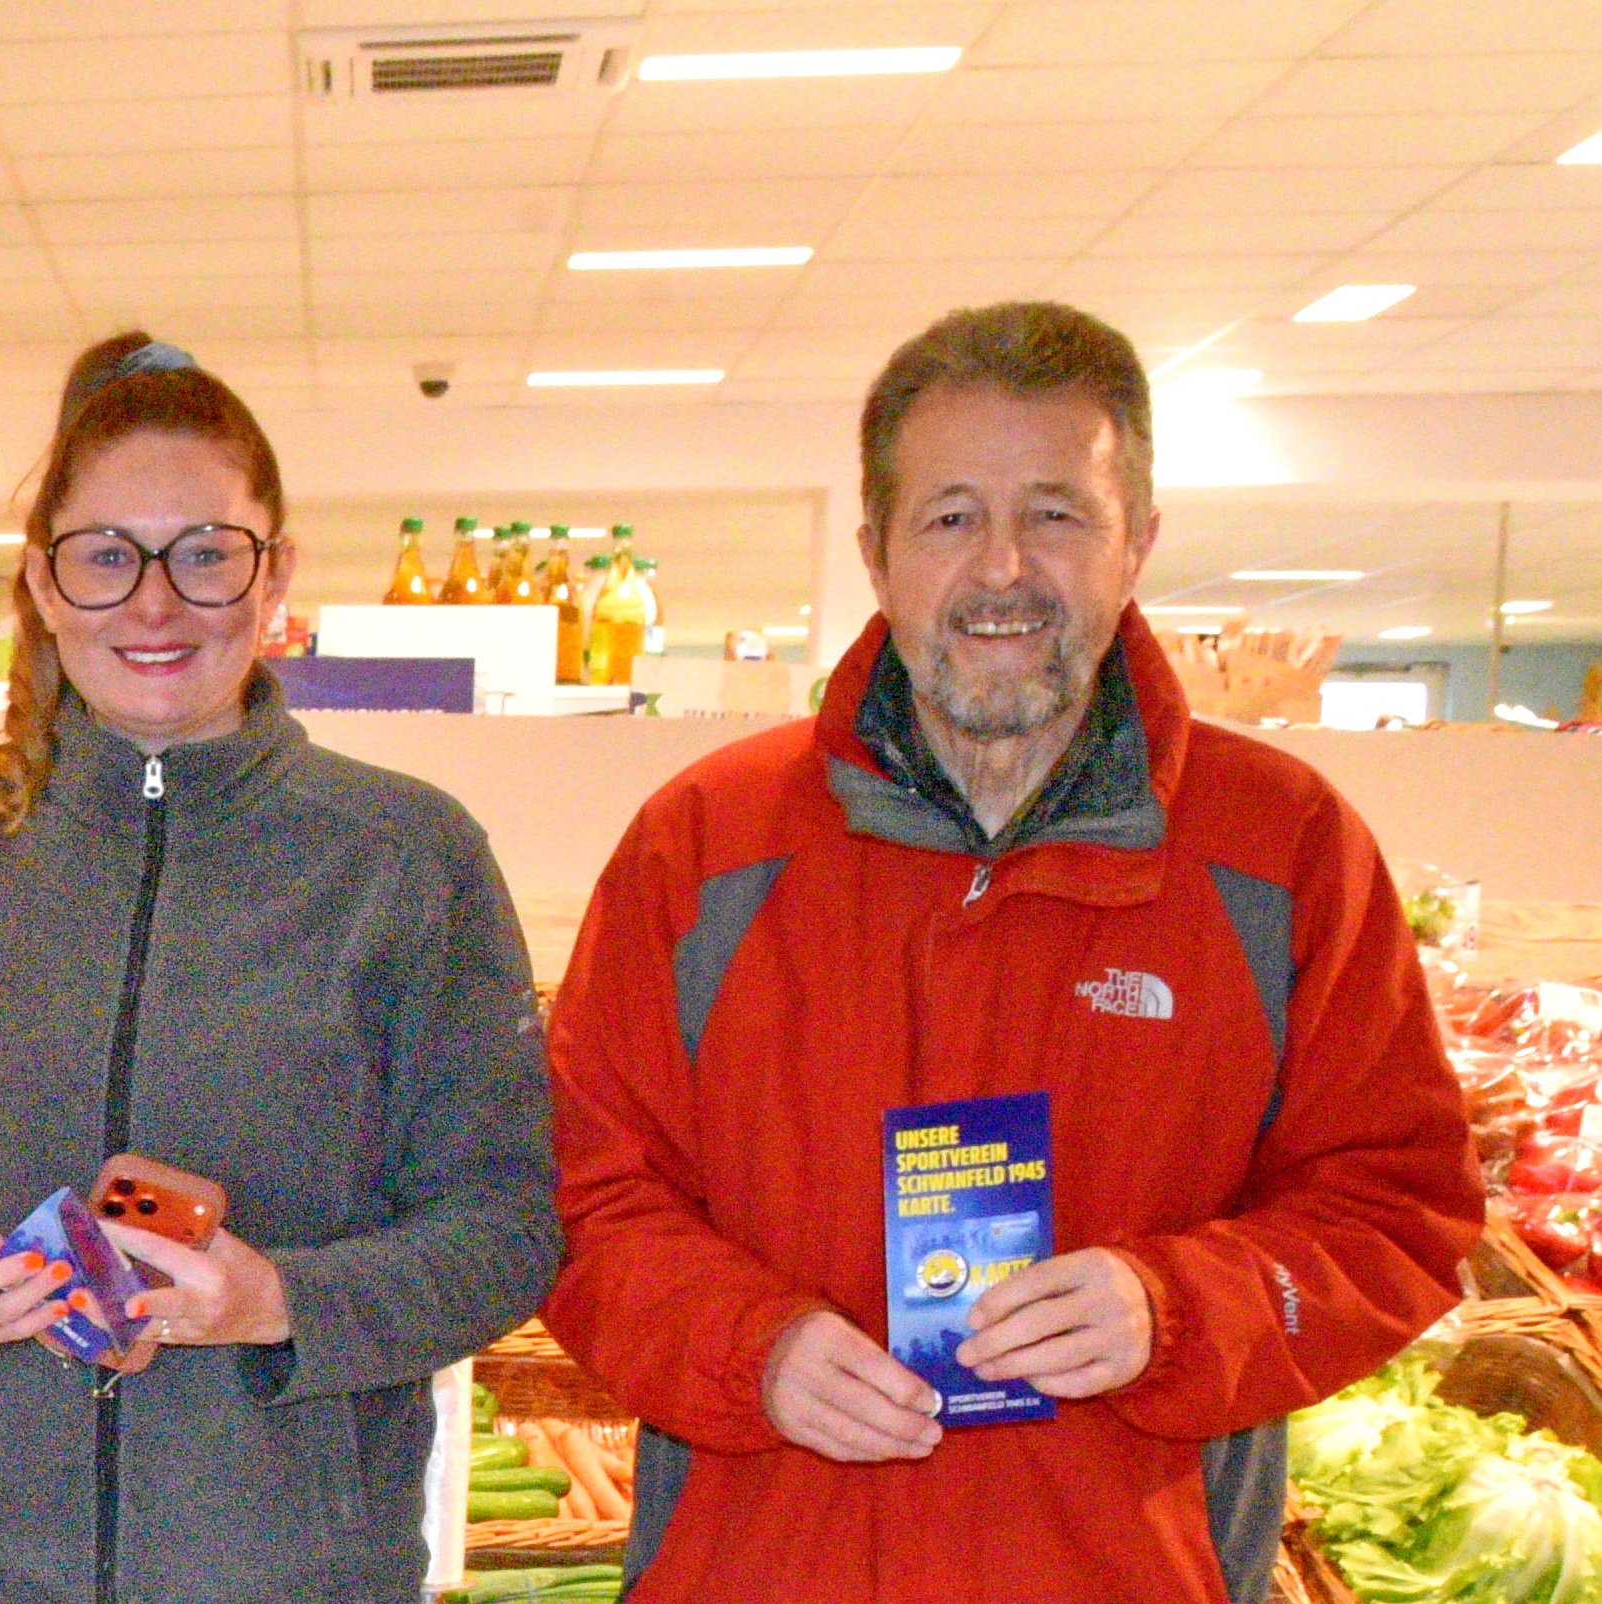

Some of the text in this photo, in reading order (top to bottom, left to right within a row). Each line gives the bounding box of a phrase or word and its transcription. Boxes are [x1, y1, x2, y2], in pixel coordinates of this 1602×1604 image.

[1104, 967, 1143, 985] THE
[1075, 981, 1141, 1001] NORTH
[1090, 998, 1141, 1017] FACE
[896, 1125, 960, 1150] UNSERE
[897, 1142, 1008, 1173] SPORTVEREIN
[897, 1160, 1046, 1195] SCHWANFELD 1945
[898, 1194, 956, 1217] KARTE.
